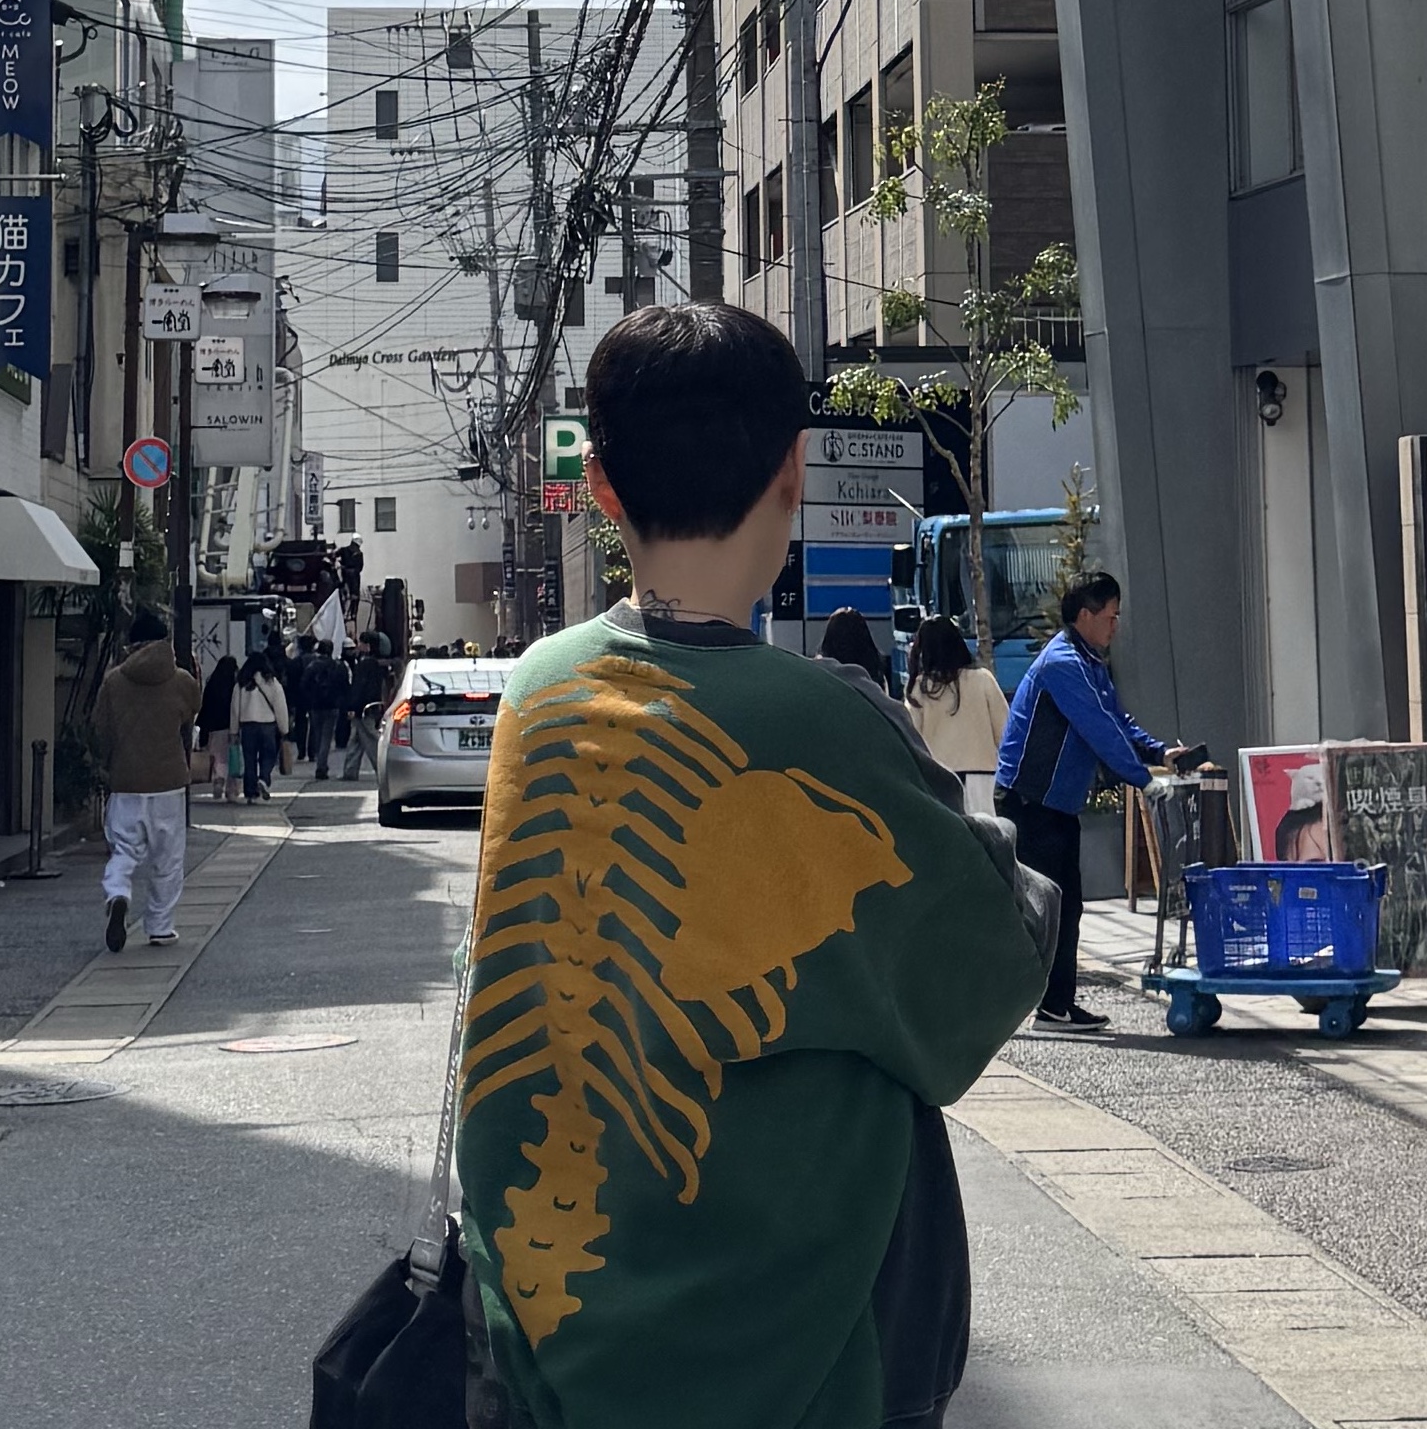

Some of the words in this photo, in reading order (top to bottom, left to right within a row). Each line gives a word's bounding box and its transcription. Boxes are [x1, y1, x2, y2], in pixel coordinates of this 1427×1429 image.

[372, 350, 404, 365] Cross
[545, 420, 587, 477] P
[780, 592, 797, 606] 2F
